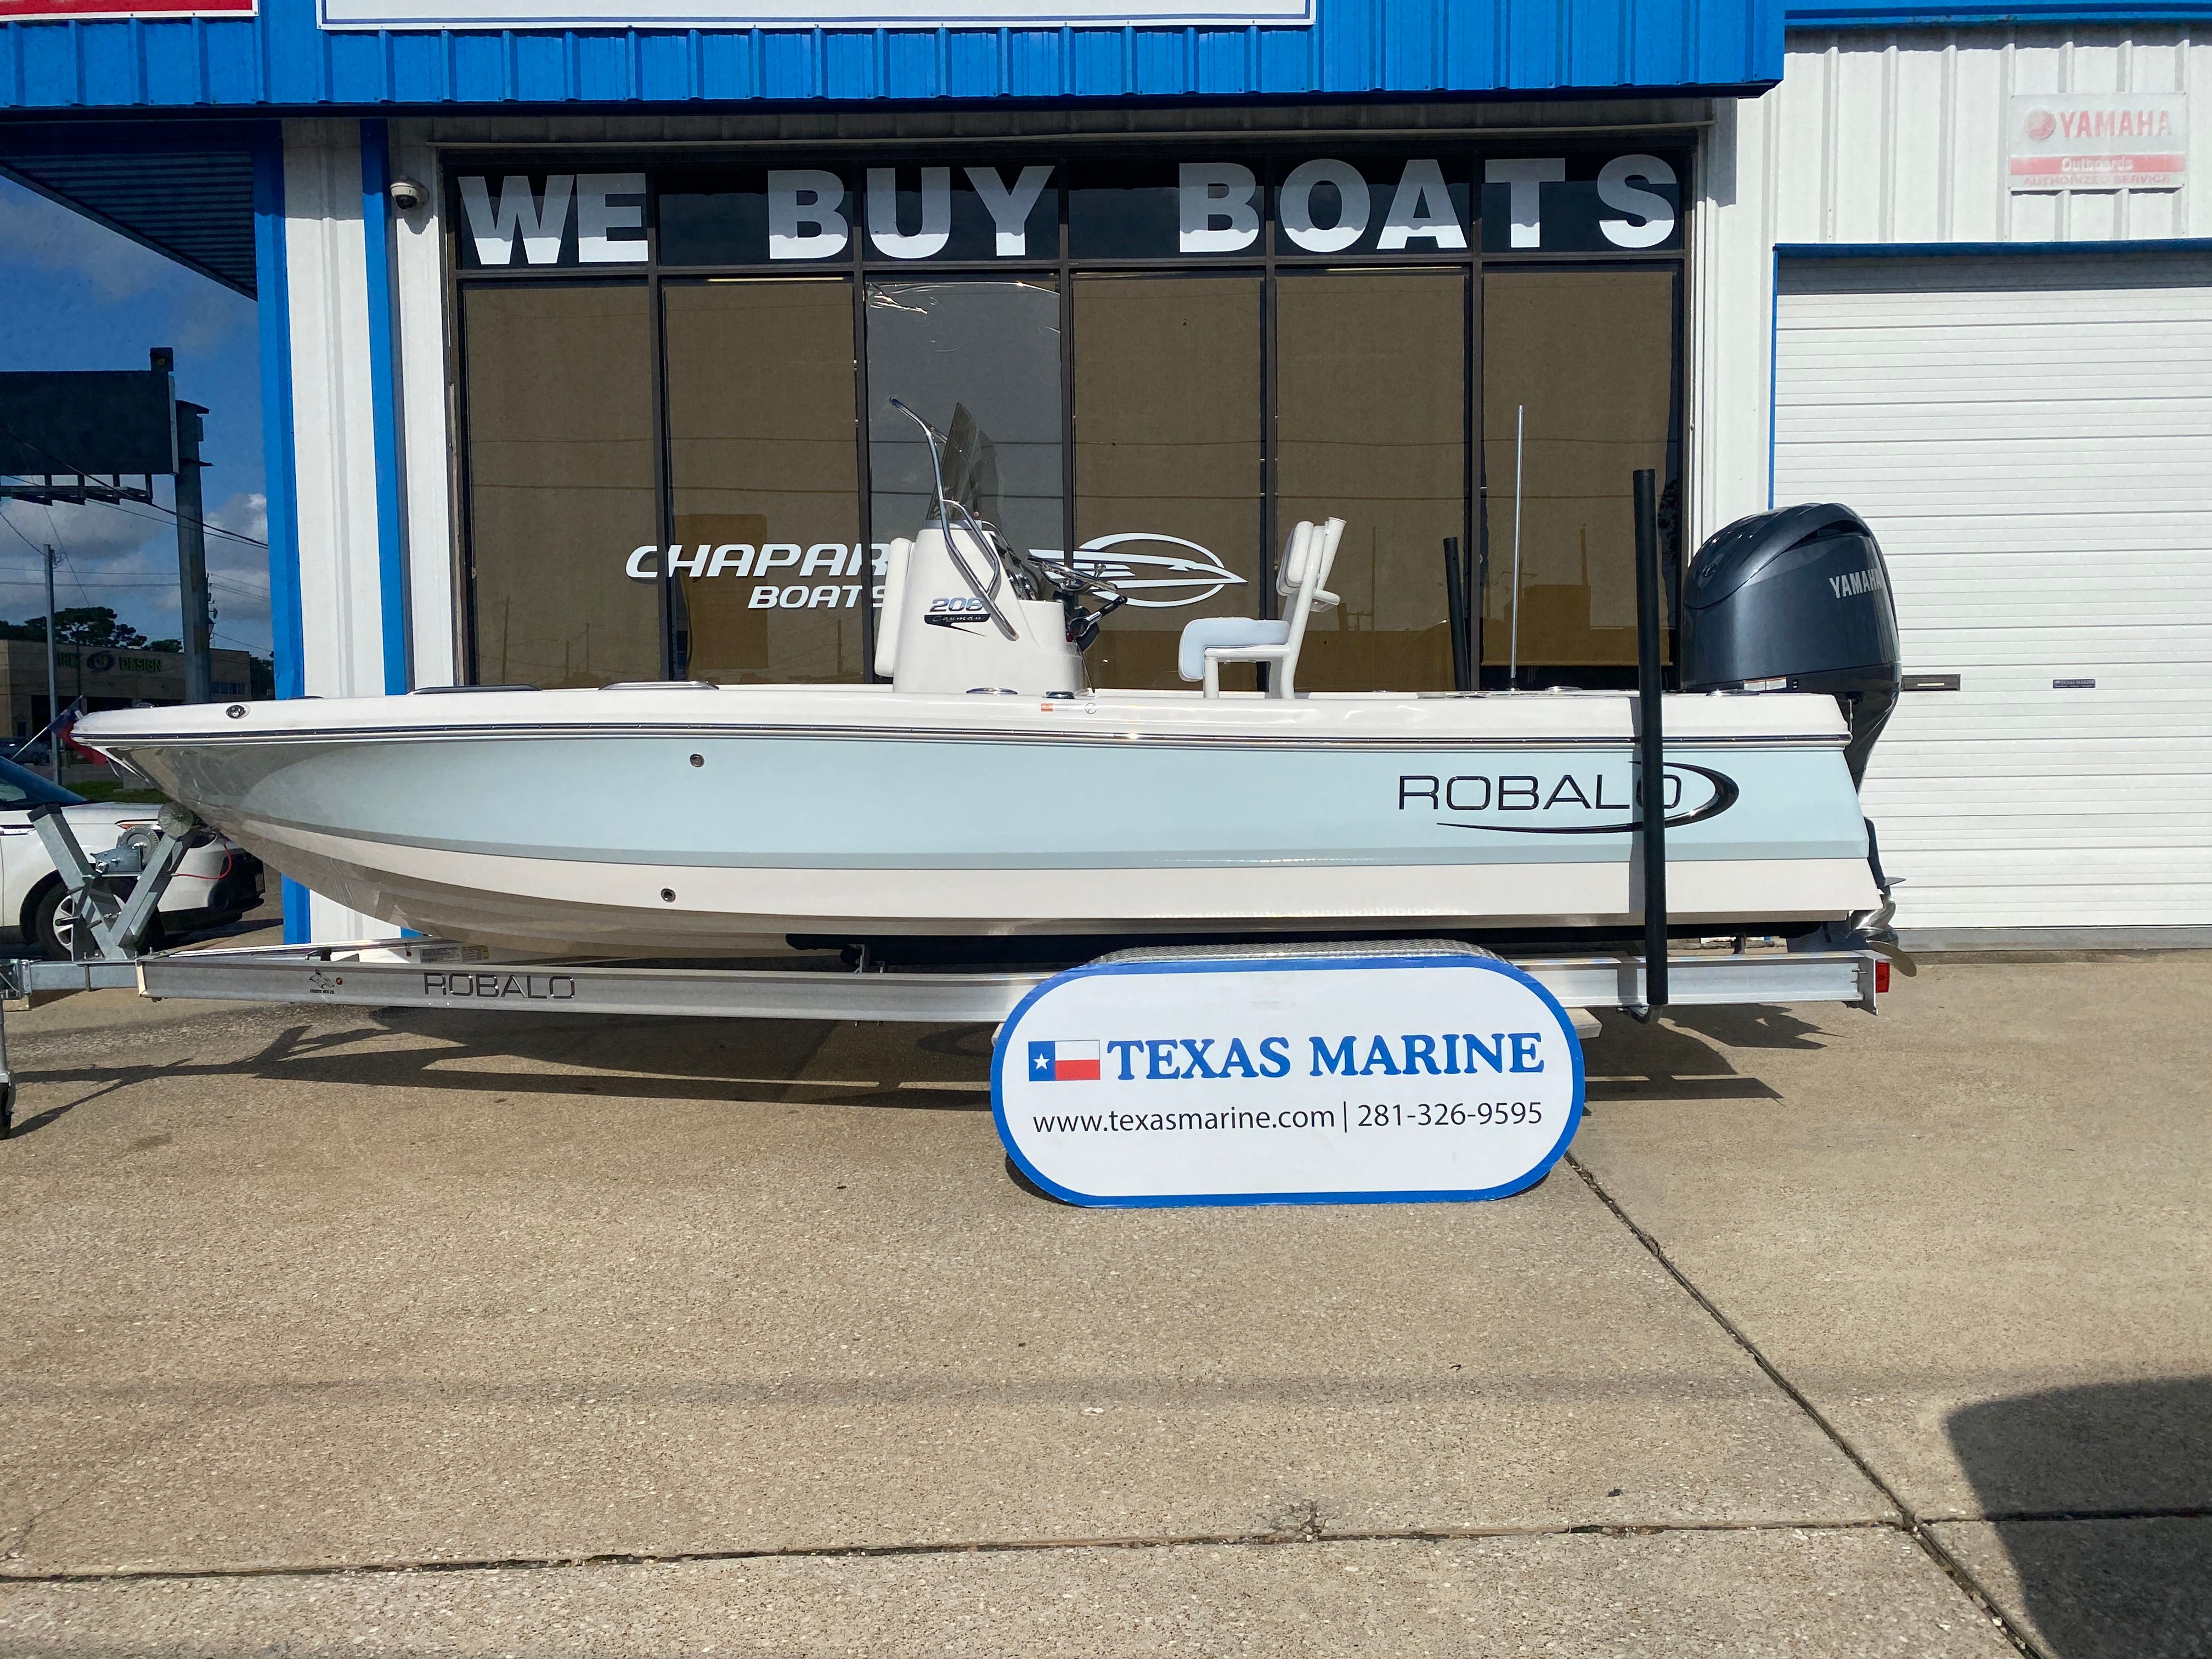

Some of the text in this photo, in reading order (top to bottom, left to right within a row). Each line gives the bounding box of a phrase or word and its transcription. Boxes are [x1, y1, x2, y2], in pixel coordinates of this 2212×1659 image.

[2059, 110, 2172, 138] YAMAHA
[2061, 157, 2134, 172] Outboards
[2023, 173, 2171, 185] AUTHORIZED SERVICE
[457, 154, 1678, 265] WE BUY BOATS
[625, 543, 891, 578] CHAPAR
[929, 597, 984, 613] 206
[119, 656, 162, 672] DESIGN
[1399, 774, 1682, 810] ROBALO
[424, 972, 575, 999] ROBALO
[1107, 1033, 1545, 1081] TEXAS MARINE
[1032, 1102, 1542, 1133] www.texasmarine.com 281-326-9595
